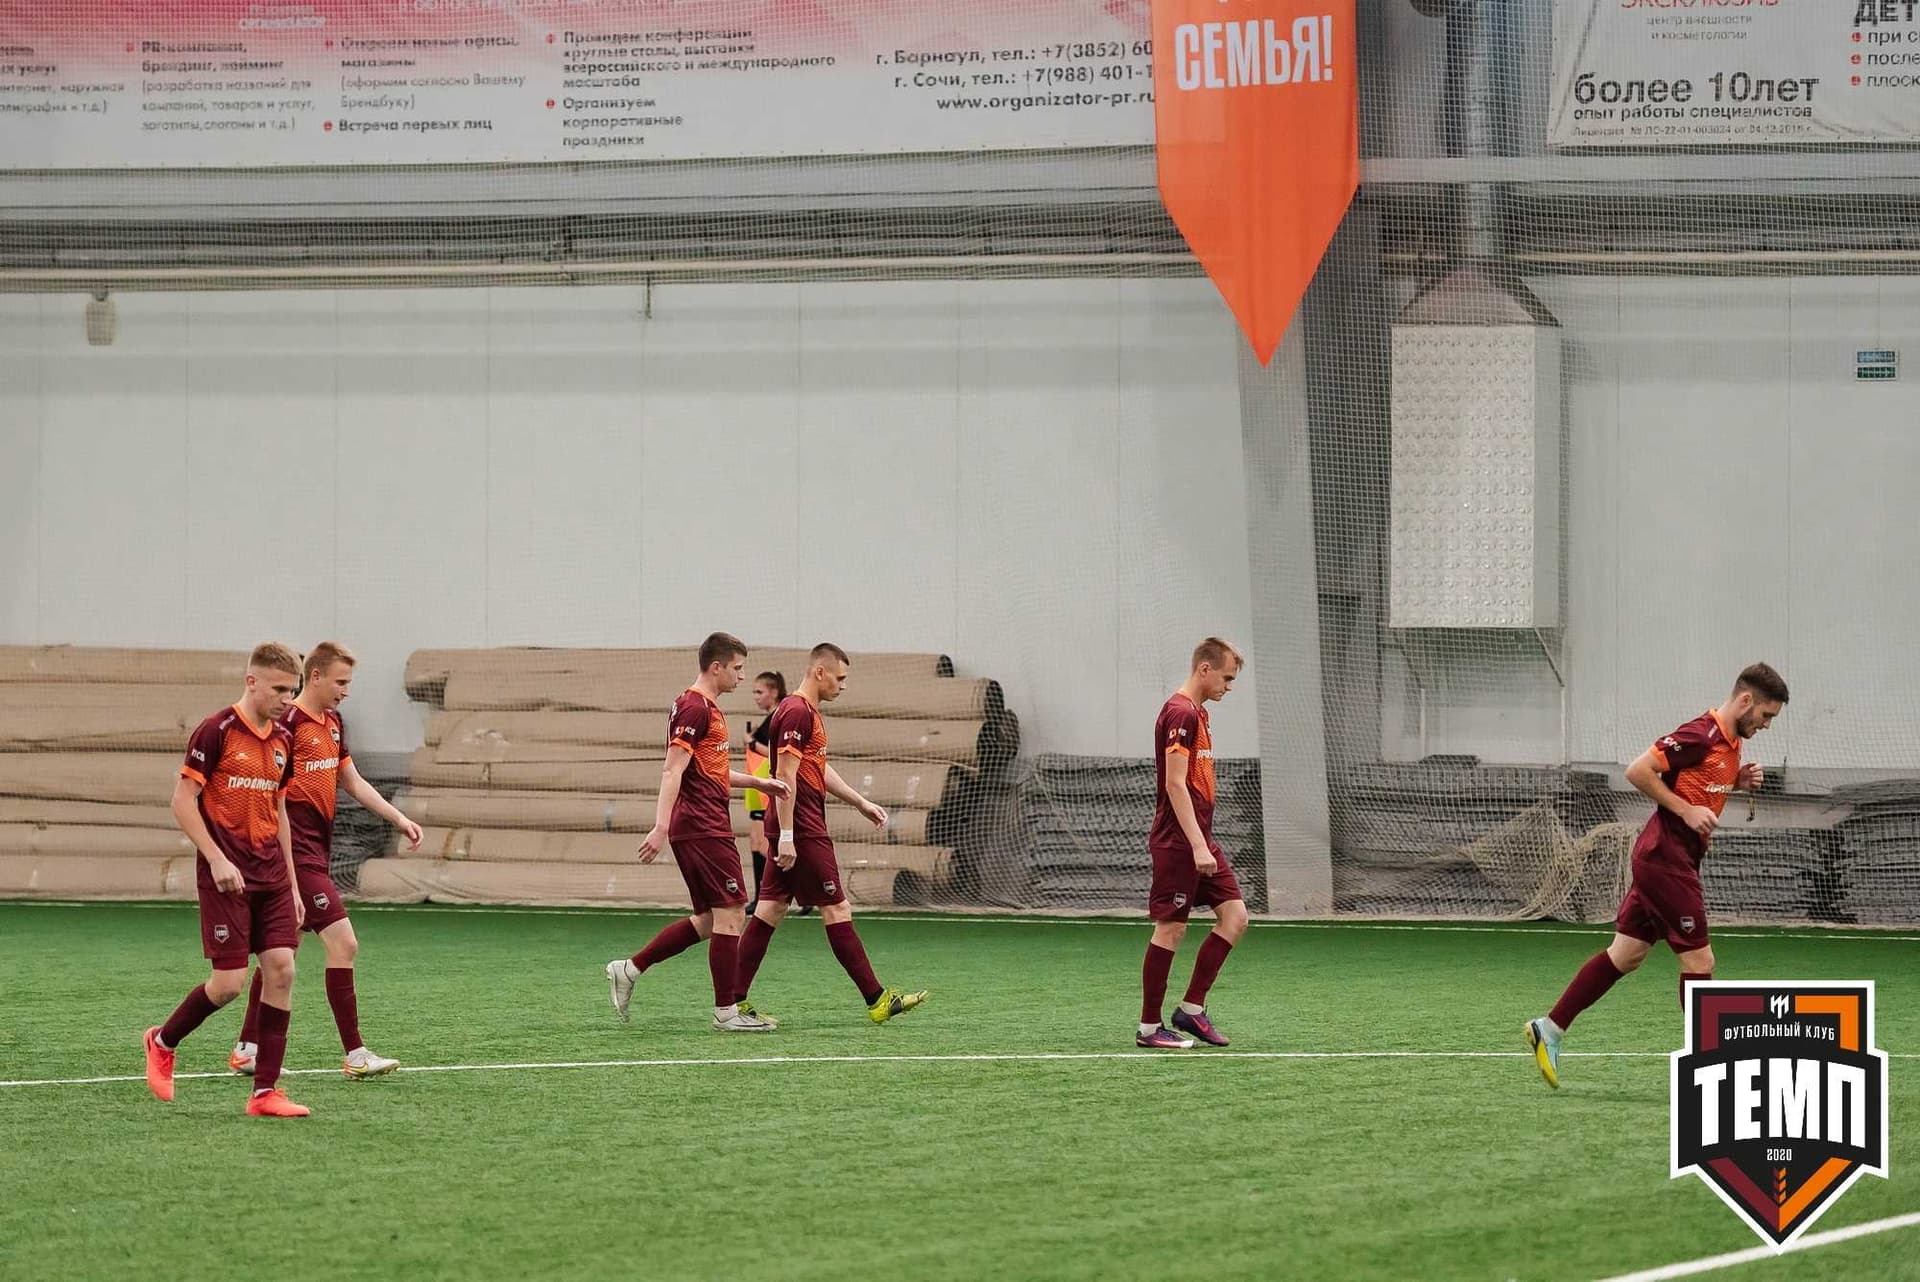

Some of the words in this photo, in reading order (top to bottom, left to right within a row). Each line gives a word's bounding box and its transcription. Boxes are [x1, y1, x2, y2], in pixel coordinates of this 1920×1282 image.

[563, 30, 641, 46] Проведем
[1868, 31, 1902, 46] при
[1908, 31, 1920, 43] с
[875, 53, 889, 65] г.
[894, 49, 987, 68] Барнаул,
[992, 47, 1036, 61] тел.:
[1041, 40, 1127, 63] +7(3852)
[1175, 15, 1333, 91] СЕМЬЯ!
[1867, 53, 1920, 65] после
[697, 54, 837, 74] международного
[562, 75, 641, 89] масштаба
[894, 75, 908, 88] г.
[913, 71, 967, 88] Сочи,
[972, 69, 1016, 84] тел.:
[1022, 67, 1096, 87] +7(988)
[1573, 72, 1694, 105] более
[562, 96, 657, 112] Организуем
[1573, 107, 1617, 121] опыт
[1621, 104, 1685, 122] работы
[1689, 105, 1813, 121] специалистов
[338, 119, 399, 134] Встреча
[402, 119, 460, 133] первых
[463, 117, 493, 131] лиц
[562, 115, 684, 132] корпоративные
[562, 134, 646, 150] праздники
